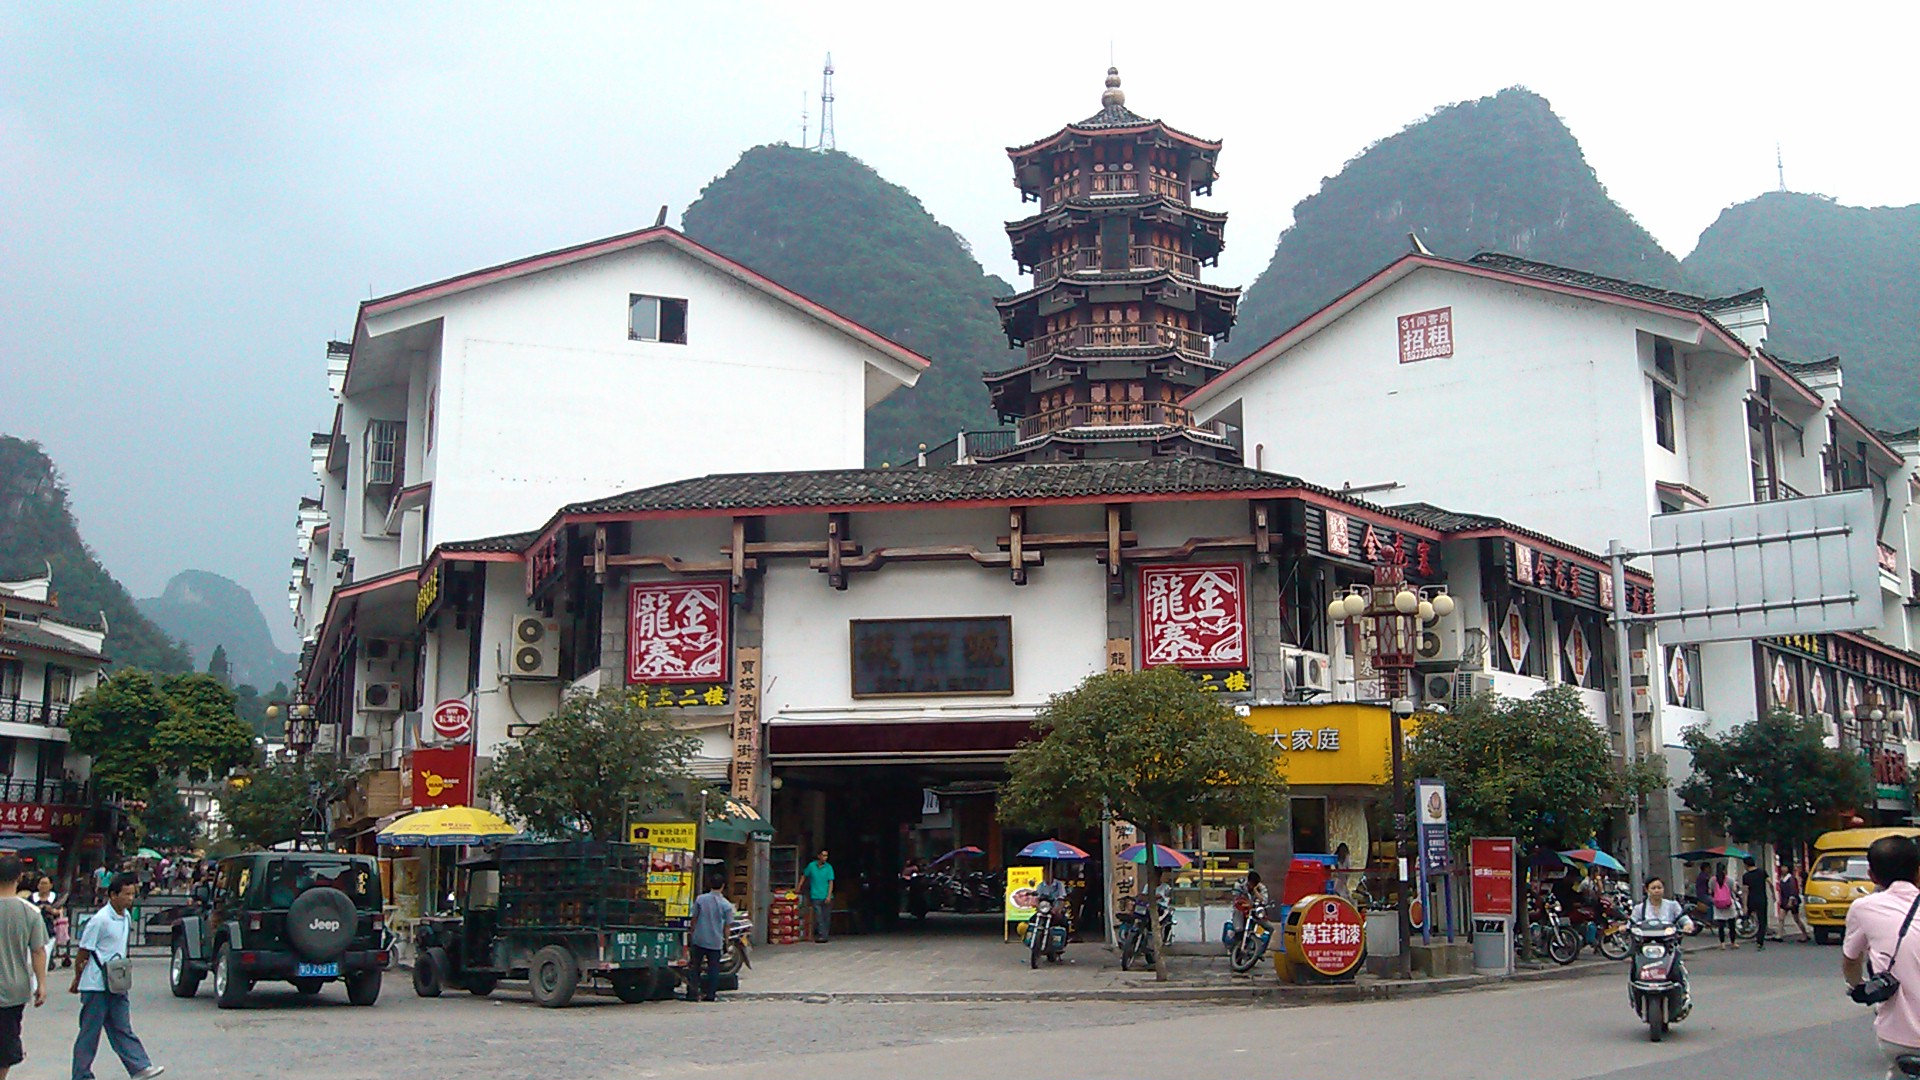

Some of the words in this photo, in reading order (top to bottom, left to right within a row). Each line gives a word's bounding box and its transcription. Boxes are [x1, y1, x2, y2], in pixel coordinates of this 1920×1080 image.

[1403, 324, 1450, 351] 招租
[1268, 728, 1340, 751] 大家庭
[309, 918, 340, 932] Jeep
[1302, 922, 1360, 945] 嘉宝莉漆
